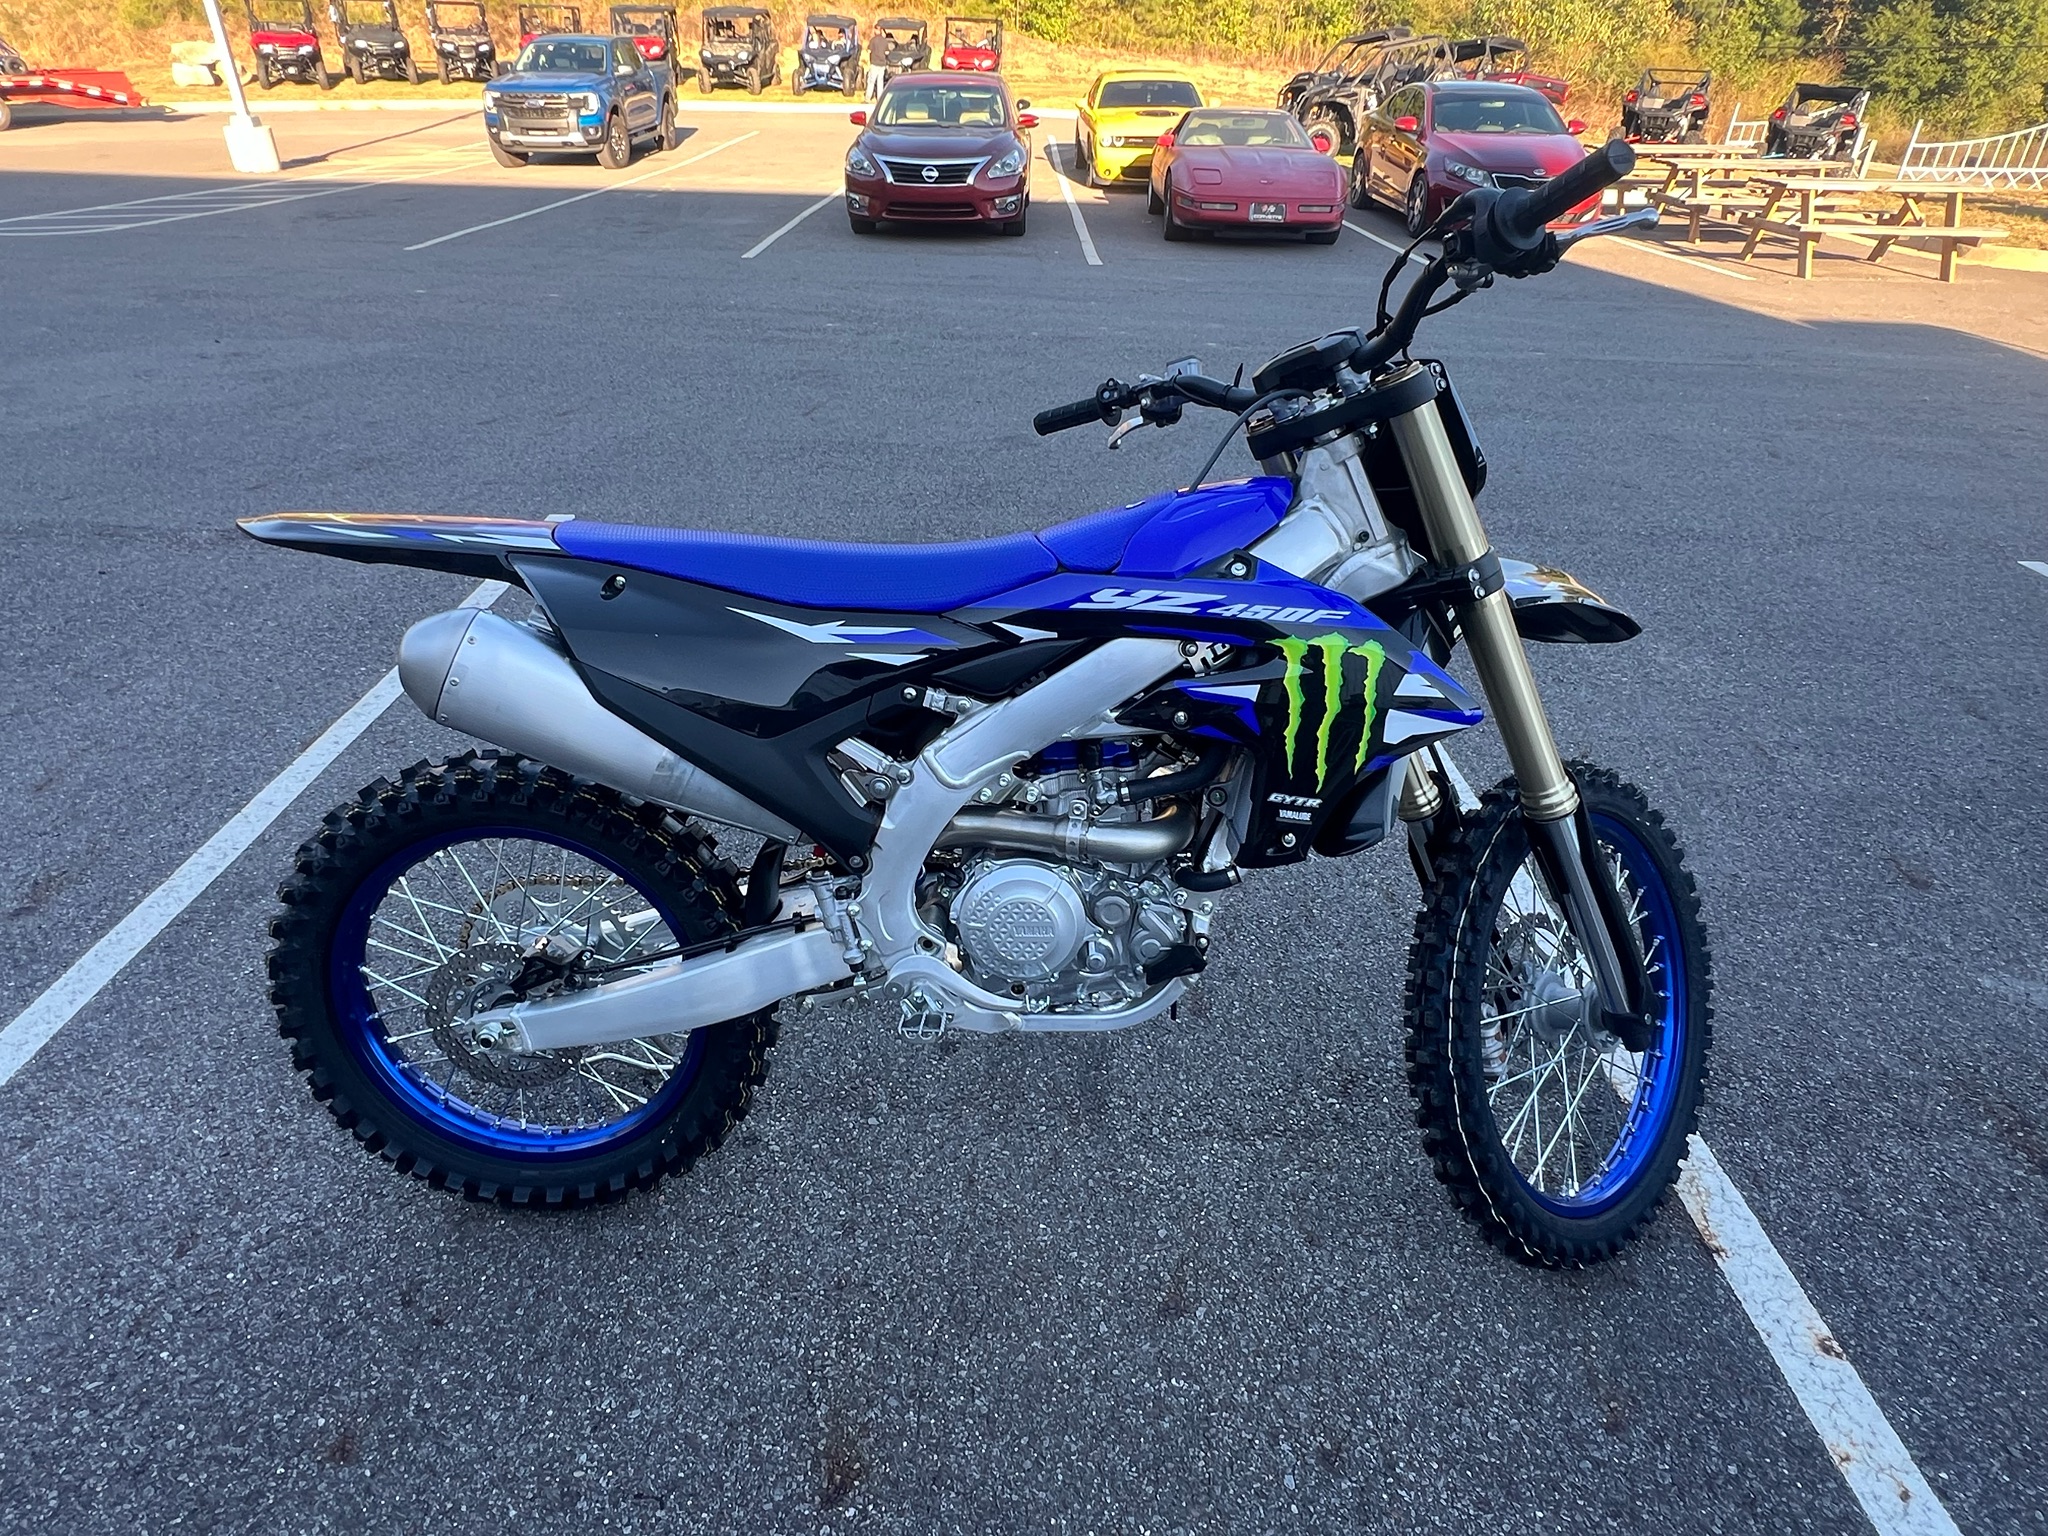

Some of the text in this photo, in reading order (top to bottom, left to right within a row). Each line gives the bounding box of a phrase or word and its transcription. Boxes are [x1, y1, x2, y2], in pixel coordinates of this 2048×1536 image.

[1068, 588, 1351, 623] YZ 450F
[1267, 792, 1323, 808] GYTR
[1013, 926, 1055, 938] YAMAHA
